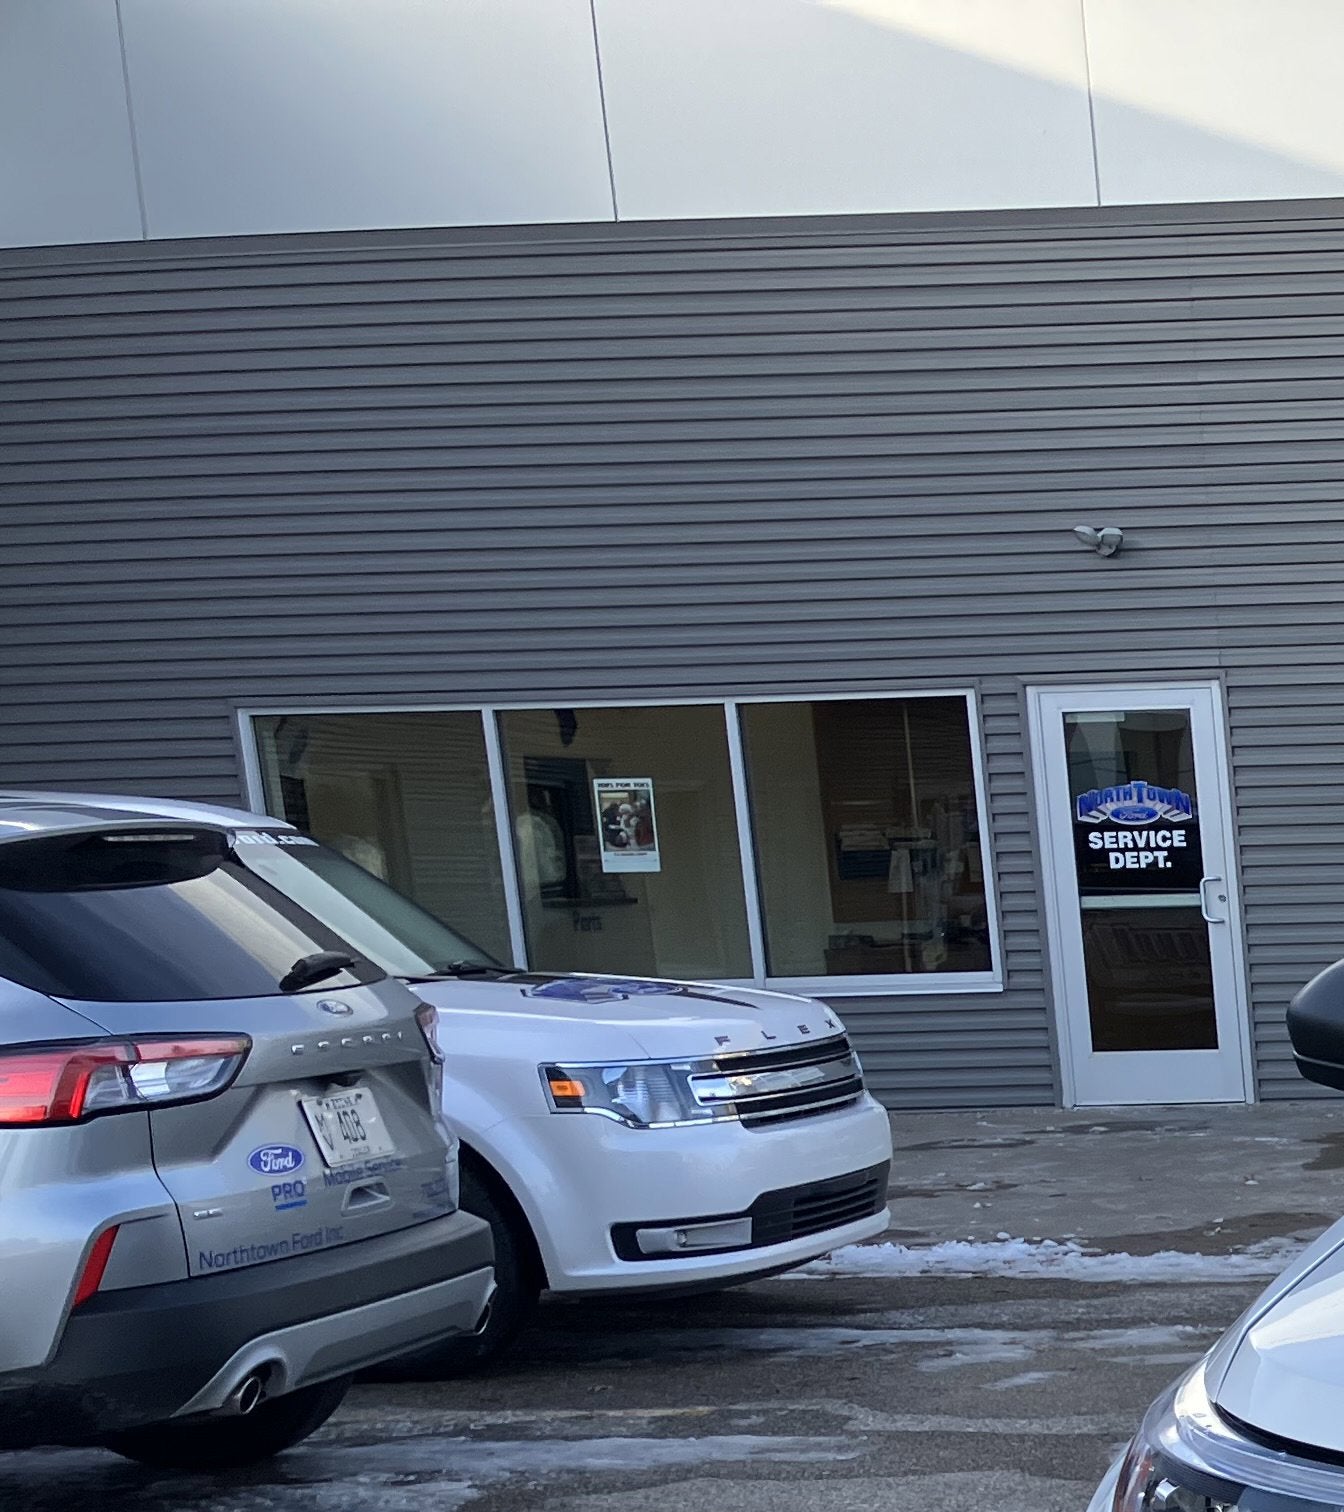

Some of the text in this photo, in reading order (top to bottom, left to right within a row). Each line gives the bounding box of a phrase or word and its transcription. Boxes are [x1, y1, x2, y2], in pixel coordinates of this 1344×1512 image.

[1088, 830, 1186, 849] SERVICE
[1109, 850, 1171, 869] DEPT.
[714, 1019, 836, 1046] FLEX
[260, 1147, 296, 1172] Ford
[271, 1180, 305, 1202] PRO
[200, 1240, 289, 1270] Northtown
[292, 1228, 323, 1251] Ford
